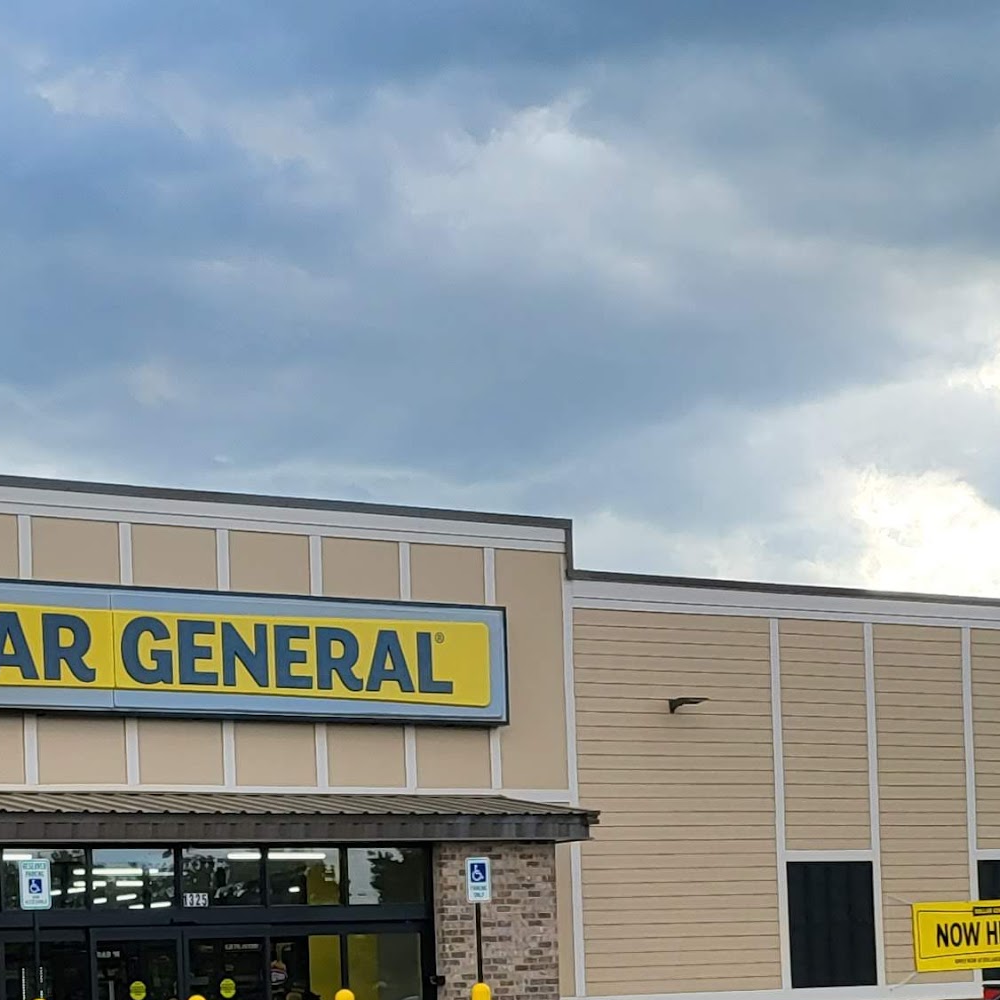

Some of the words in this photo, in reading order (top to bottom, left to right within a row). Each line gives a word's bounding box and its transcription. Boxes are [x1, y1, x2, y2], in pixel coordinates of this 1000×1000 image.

[121, 616, 453, 694] GENERAL
[183, 893, 208, 907] 1325
[936, 921, 980, 948] NOW
